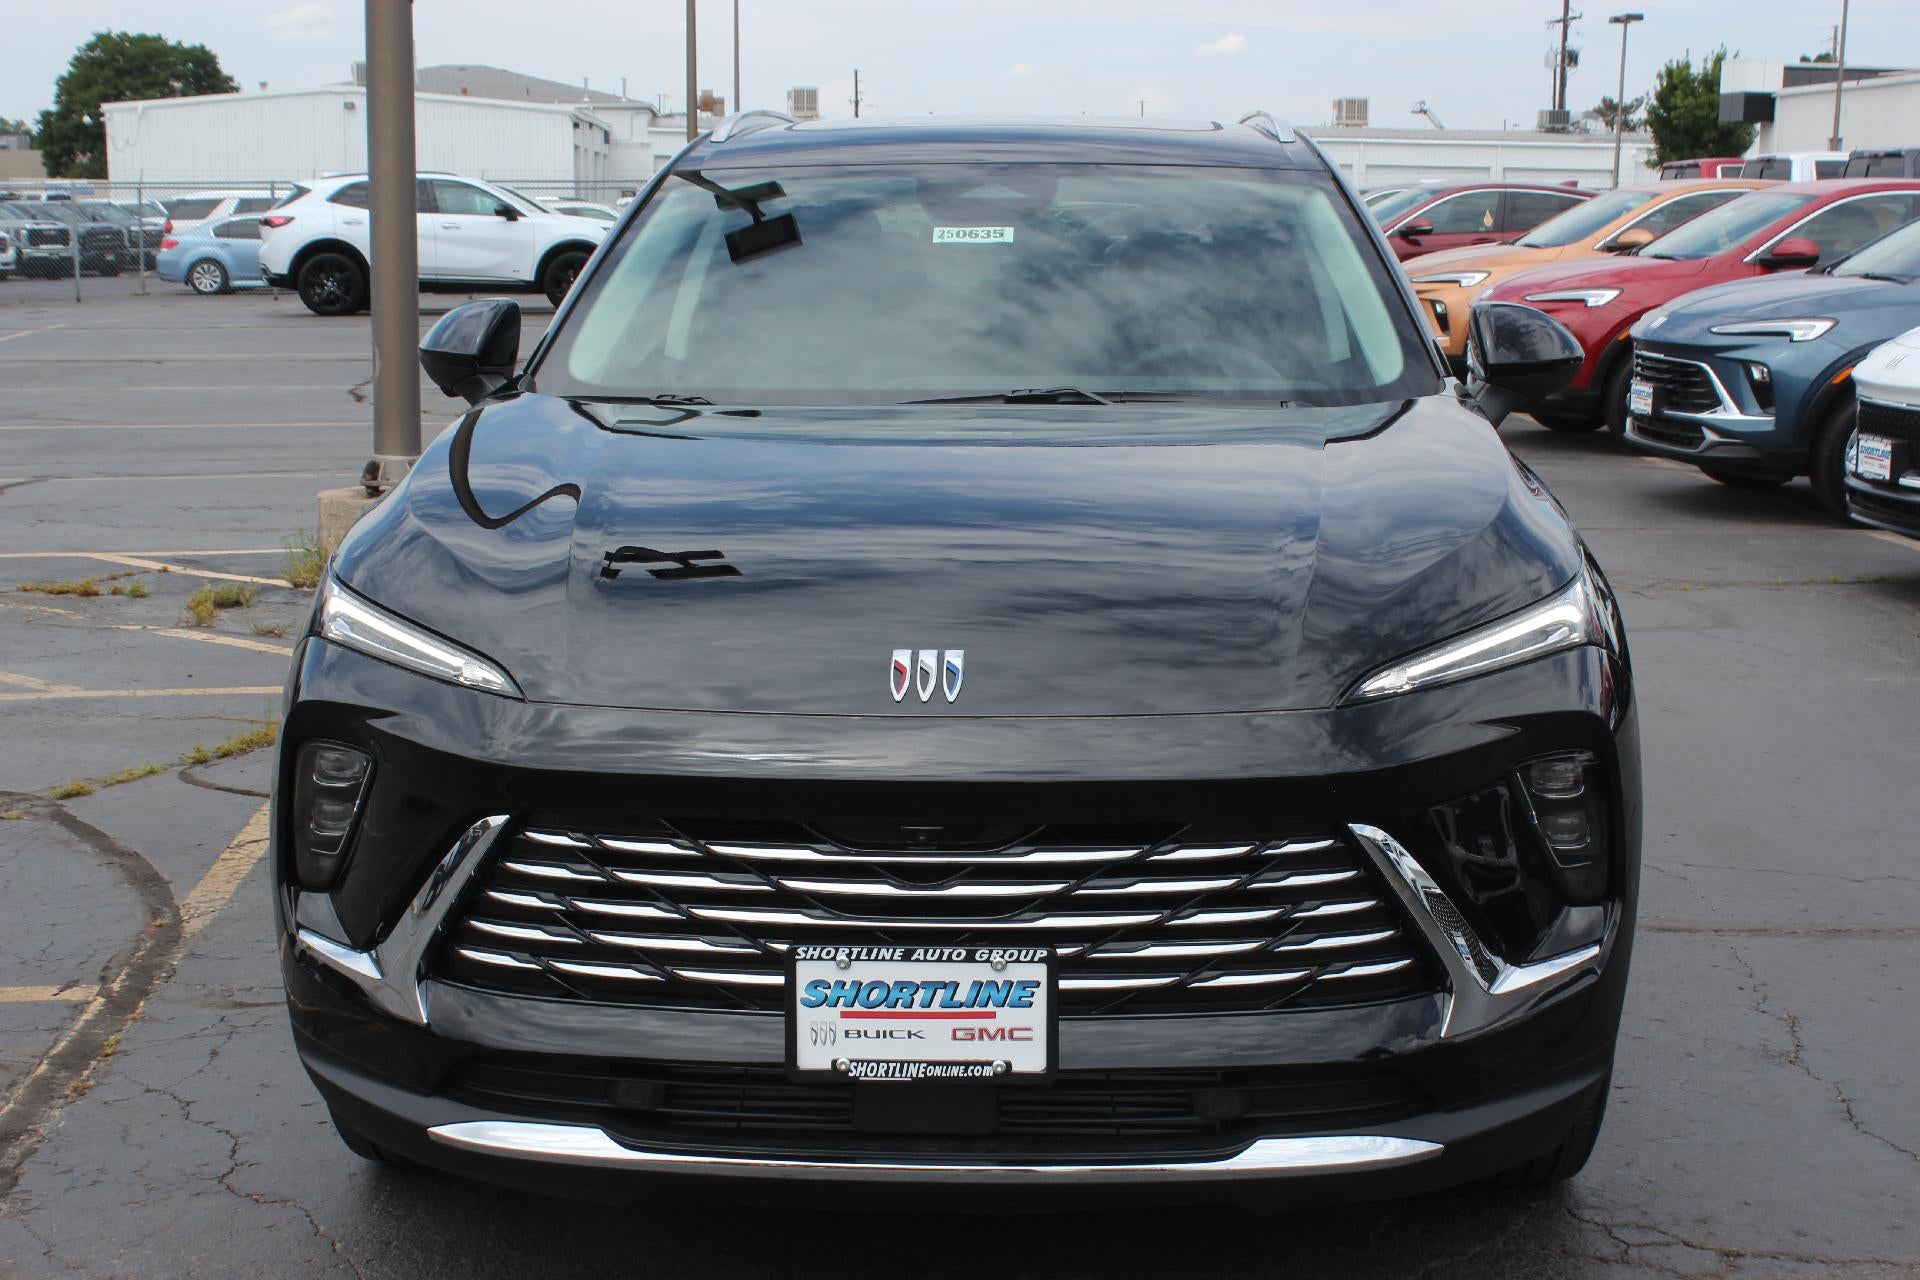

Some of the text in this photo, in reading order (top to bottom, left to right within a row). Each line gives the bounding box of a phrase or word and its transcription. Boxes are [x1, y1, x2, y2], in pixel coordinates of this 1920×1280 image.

[937, 229, 1004, 239] 250635
[795, 947, 1048, 961] SHORTLINE AUTO GROUP
[800, 979, 1040, 1009] SHORTLINE
[845, 1027, 1033, 1041] BUICK GMC
